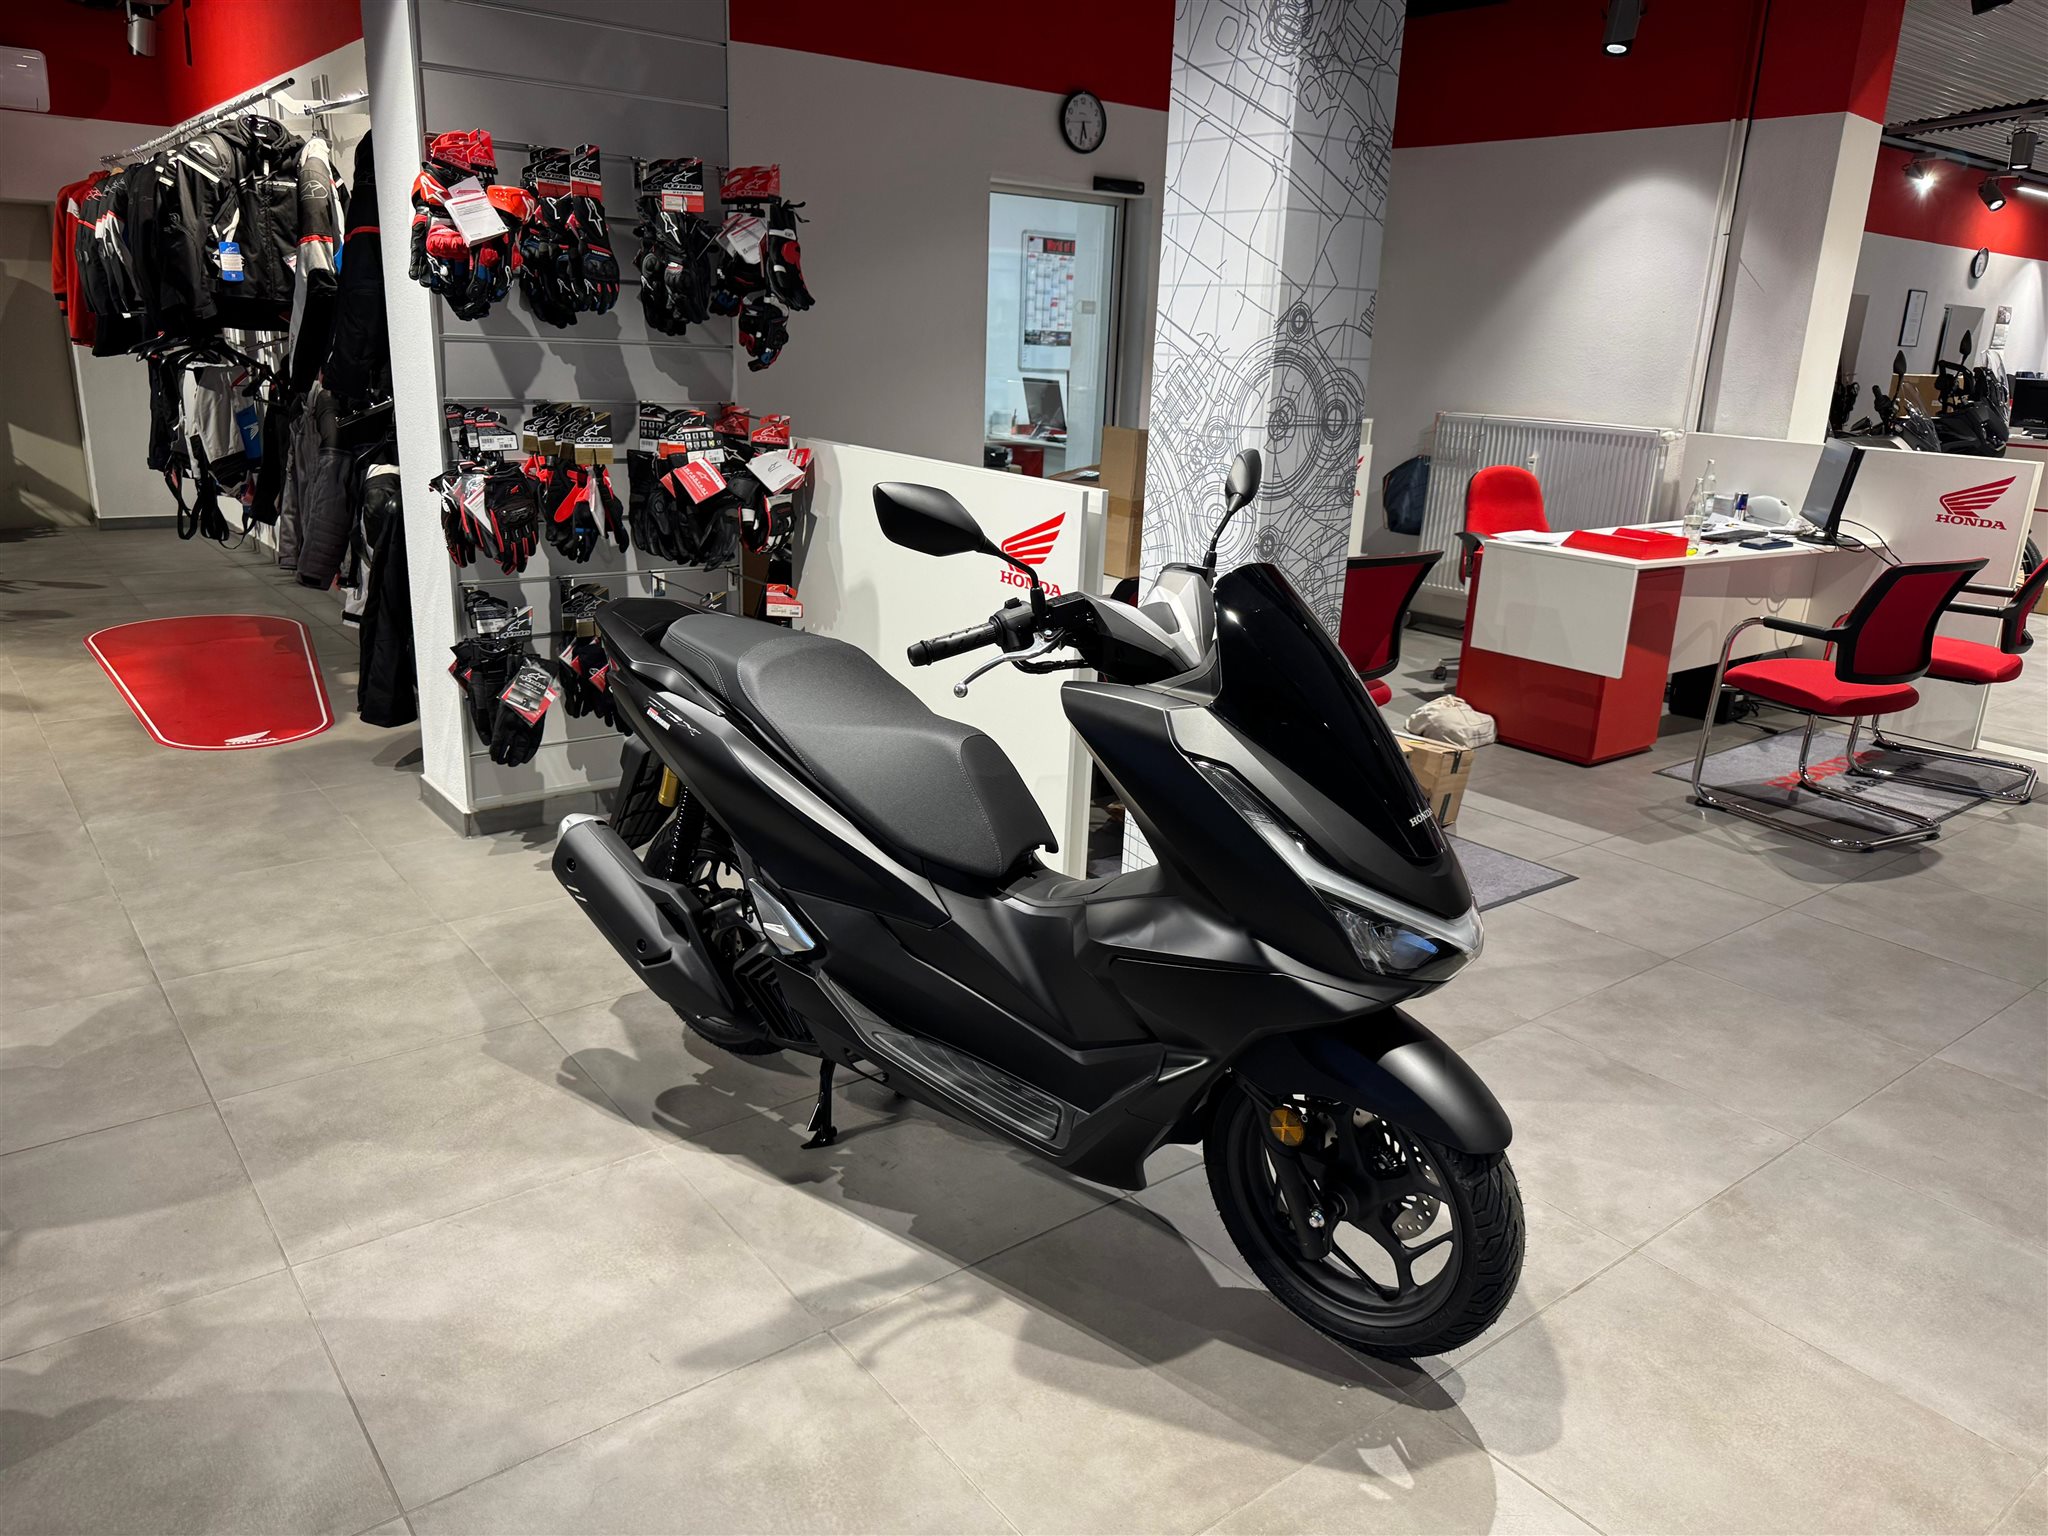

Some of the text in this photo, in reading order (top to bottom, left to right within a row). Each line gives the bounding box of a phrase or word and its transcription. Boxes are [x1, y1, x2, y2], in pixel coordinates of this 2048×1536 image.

[1935, 514, 2007, 530] HONDA
[1000, 570, 1062, 597] HONDA
[1409, 808, 1433, 828] HONDA
